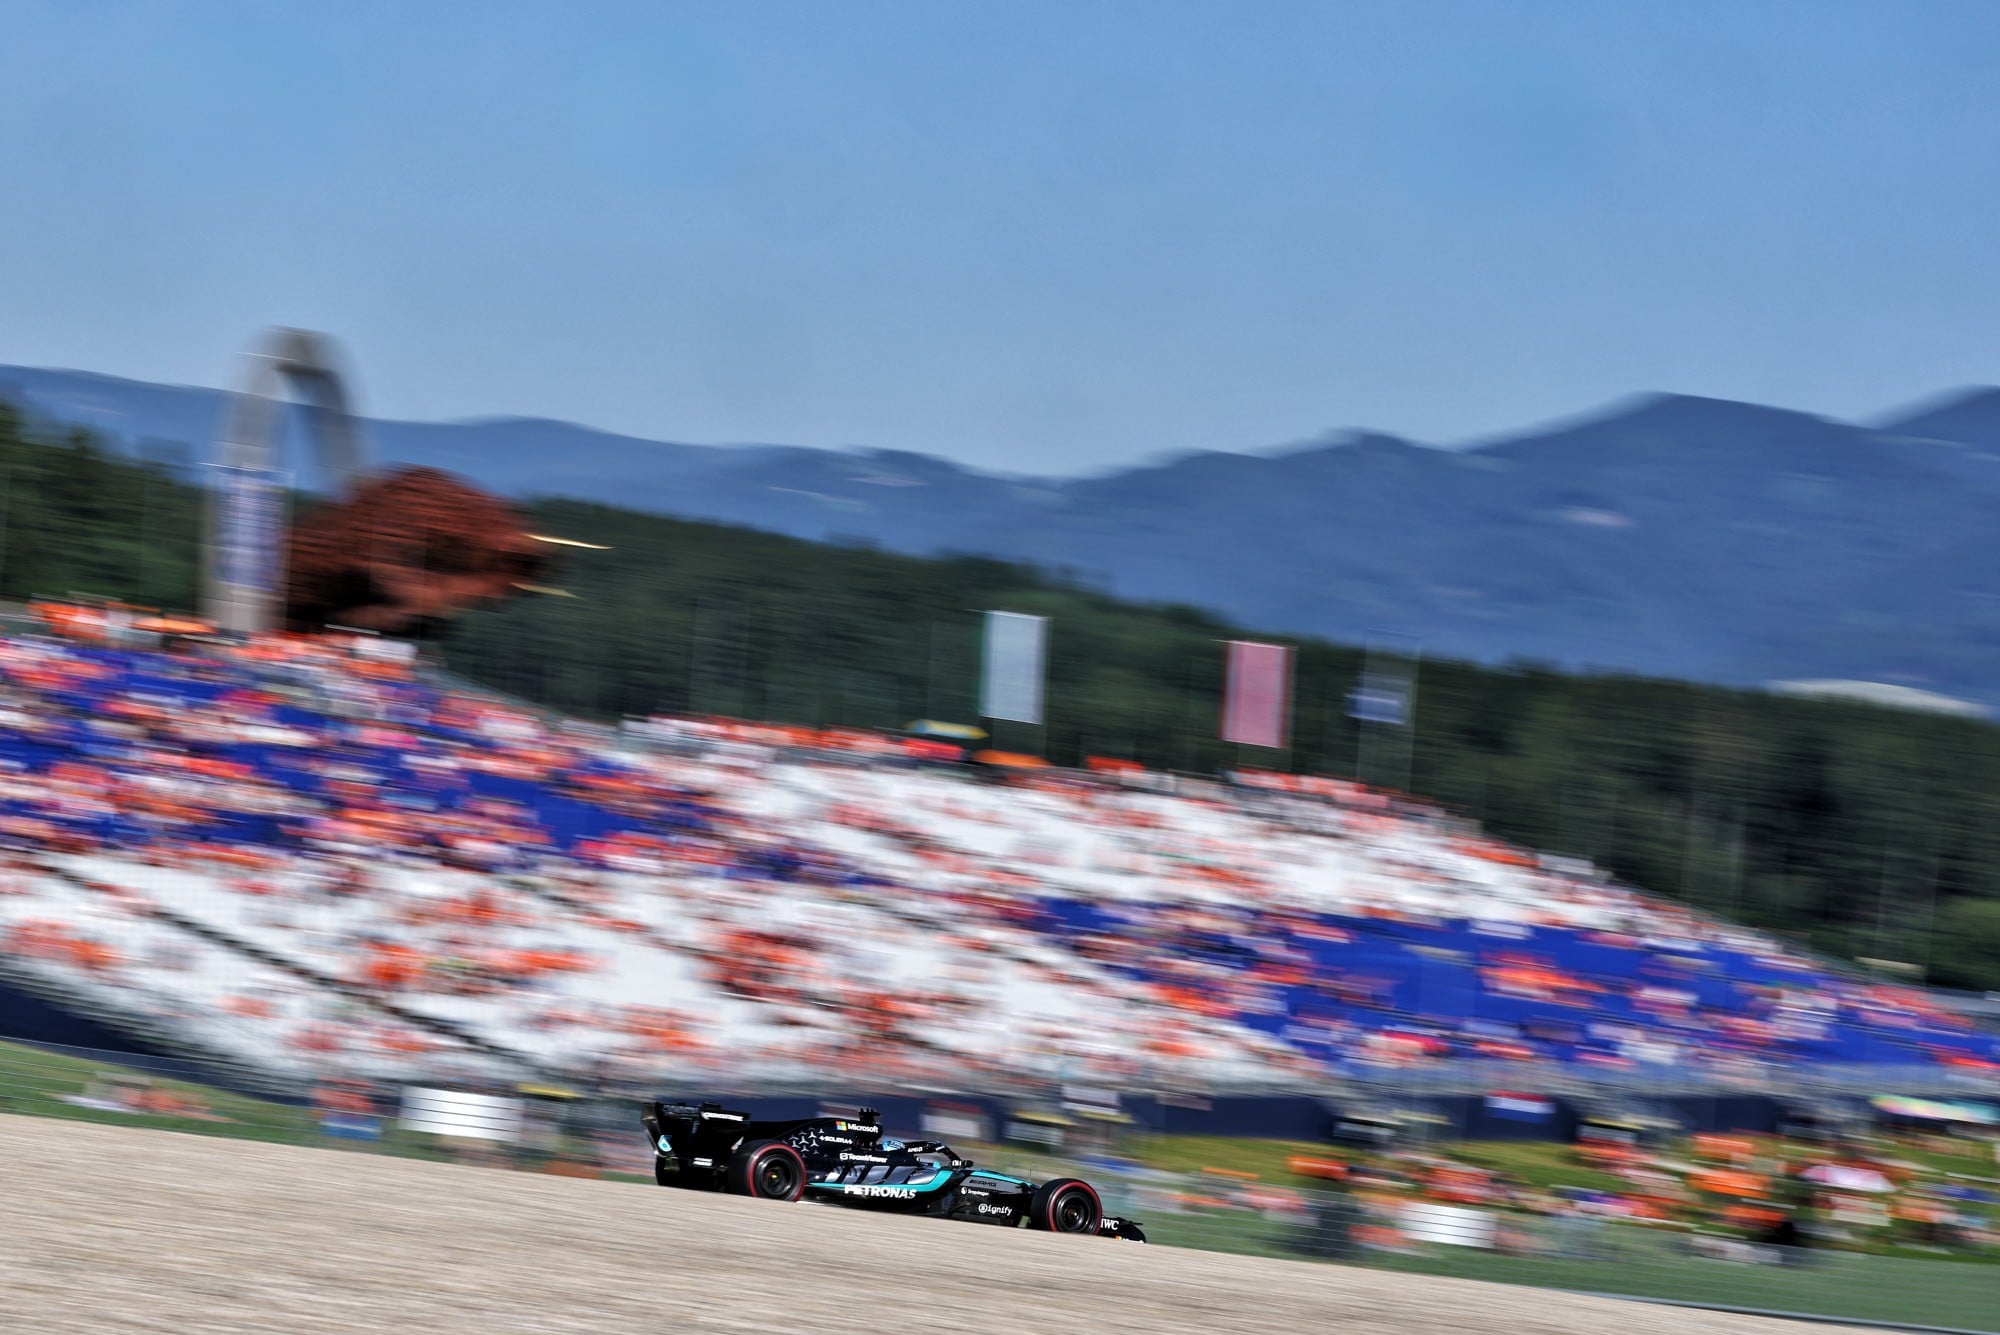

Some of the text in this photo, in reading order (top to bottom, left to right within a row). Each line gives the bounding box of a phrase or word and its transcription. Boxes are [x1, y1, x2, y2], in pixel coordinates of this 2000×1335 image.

[848, 1123, 879, 1133] Microsoft
[848, 1153, 888, 1163] TeamViewer
[844, 1184, 917, 1199] PETRONAS
[1100, 1218, 1119, 1230] IWC
